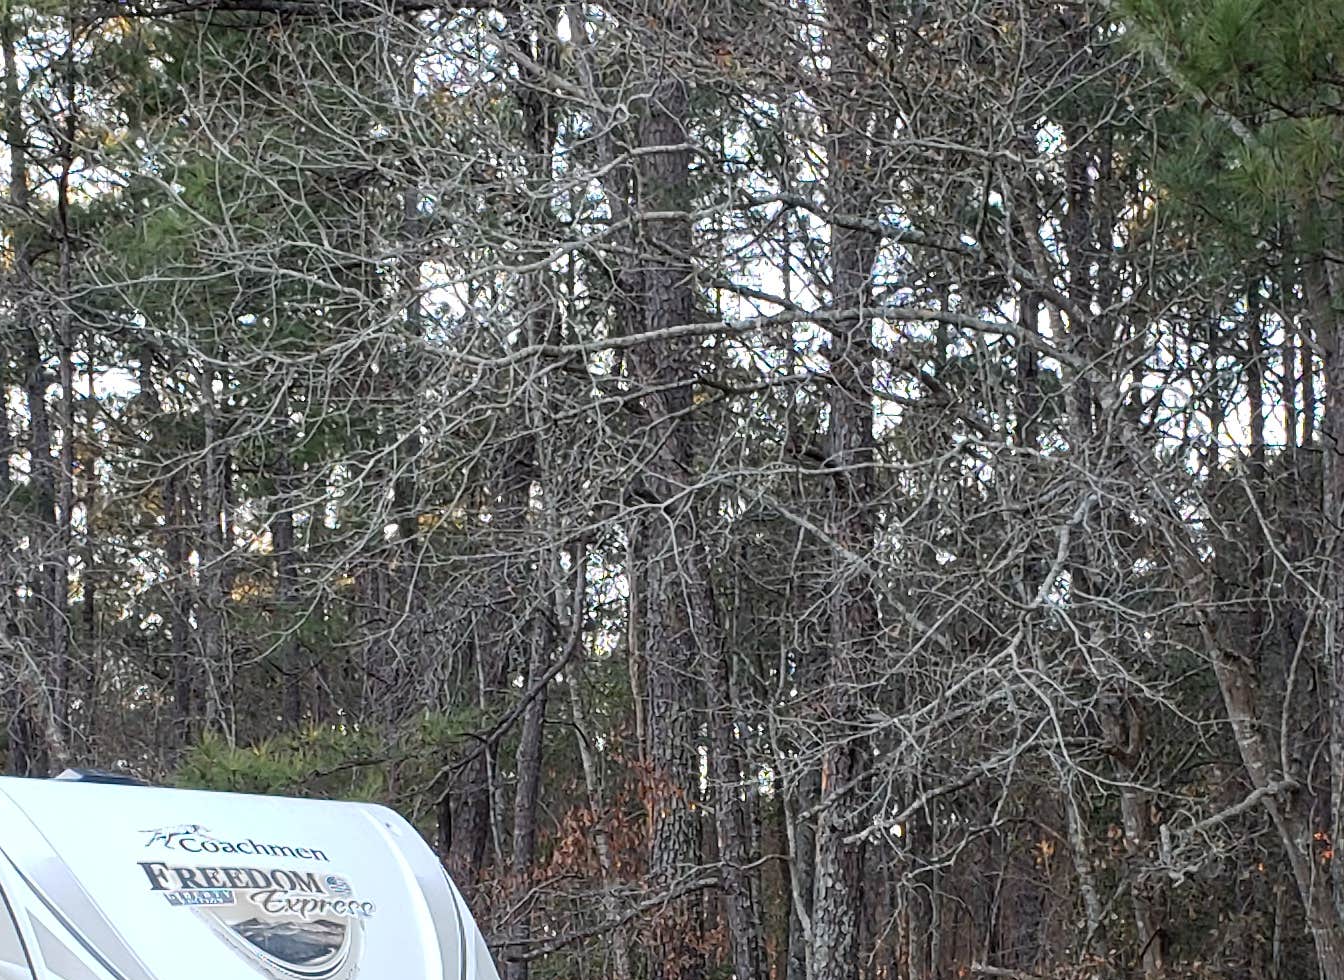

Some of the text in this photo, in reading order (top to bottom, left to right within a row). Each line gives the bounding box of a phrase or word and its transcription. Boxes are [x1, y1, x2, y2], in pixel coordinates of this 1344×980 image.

[178, 837, 330, 862] Coachmen
[137, 861, 327, 894] FREEDOM
[250, 889, 376, 918] Express
